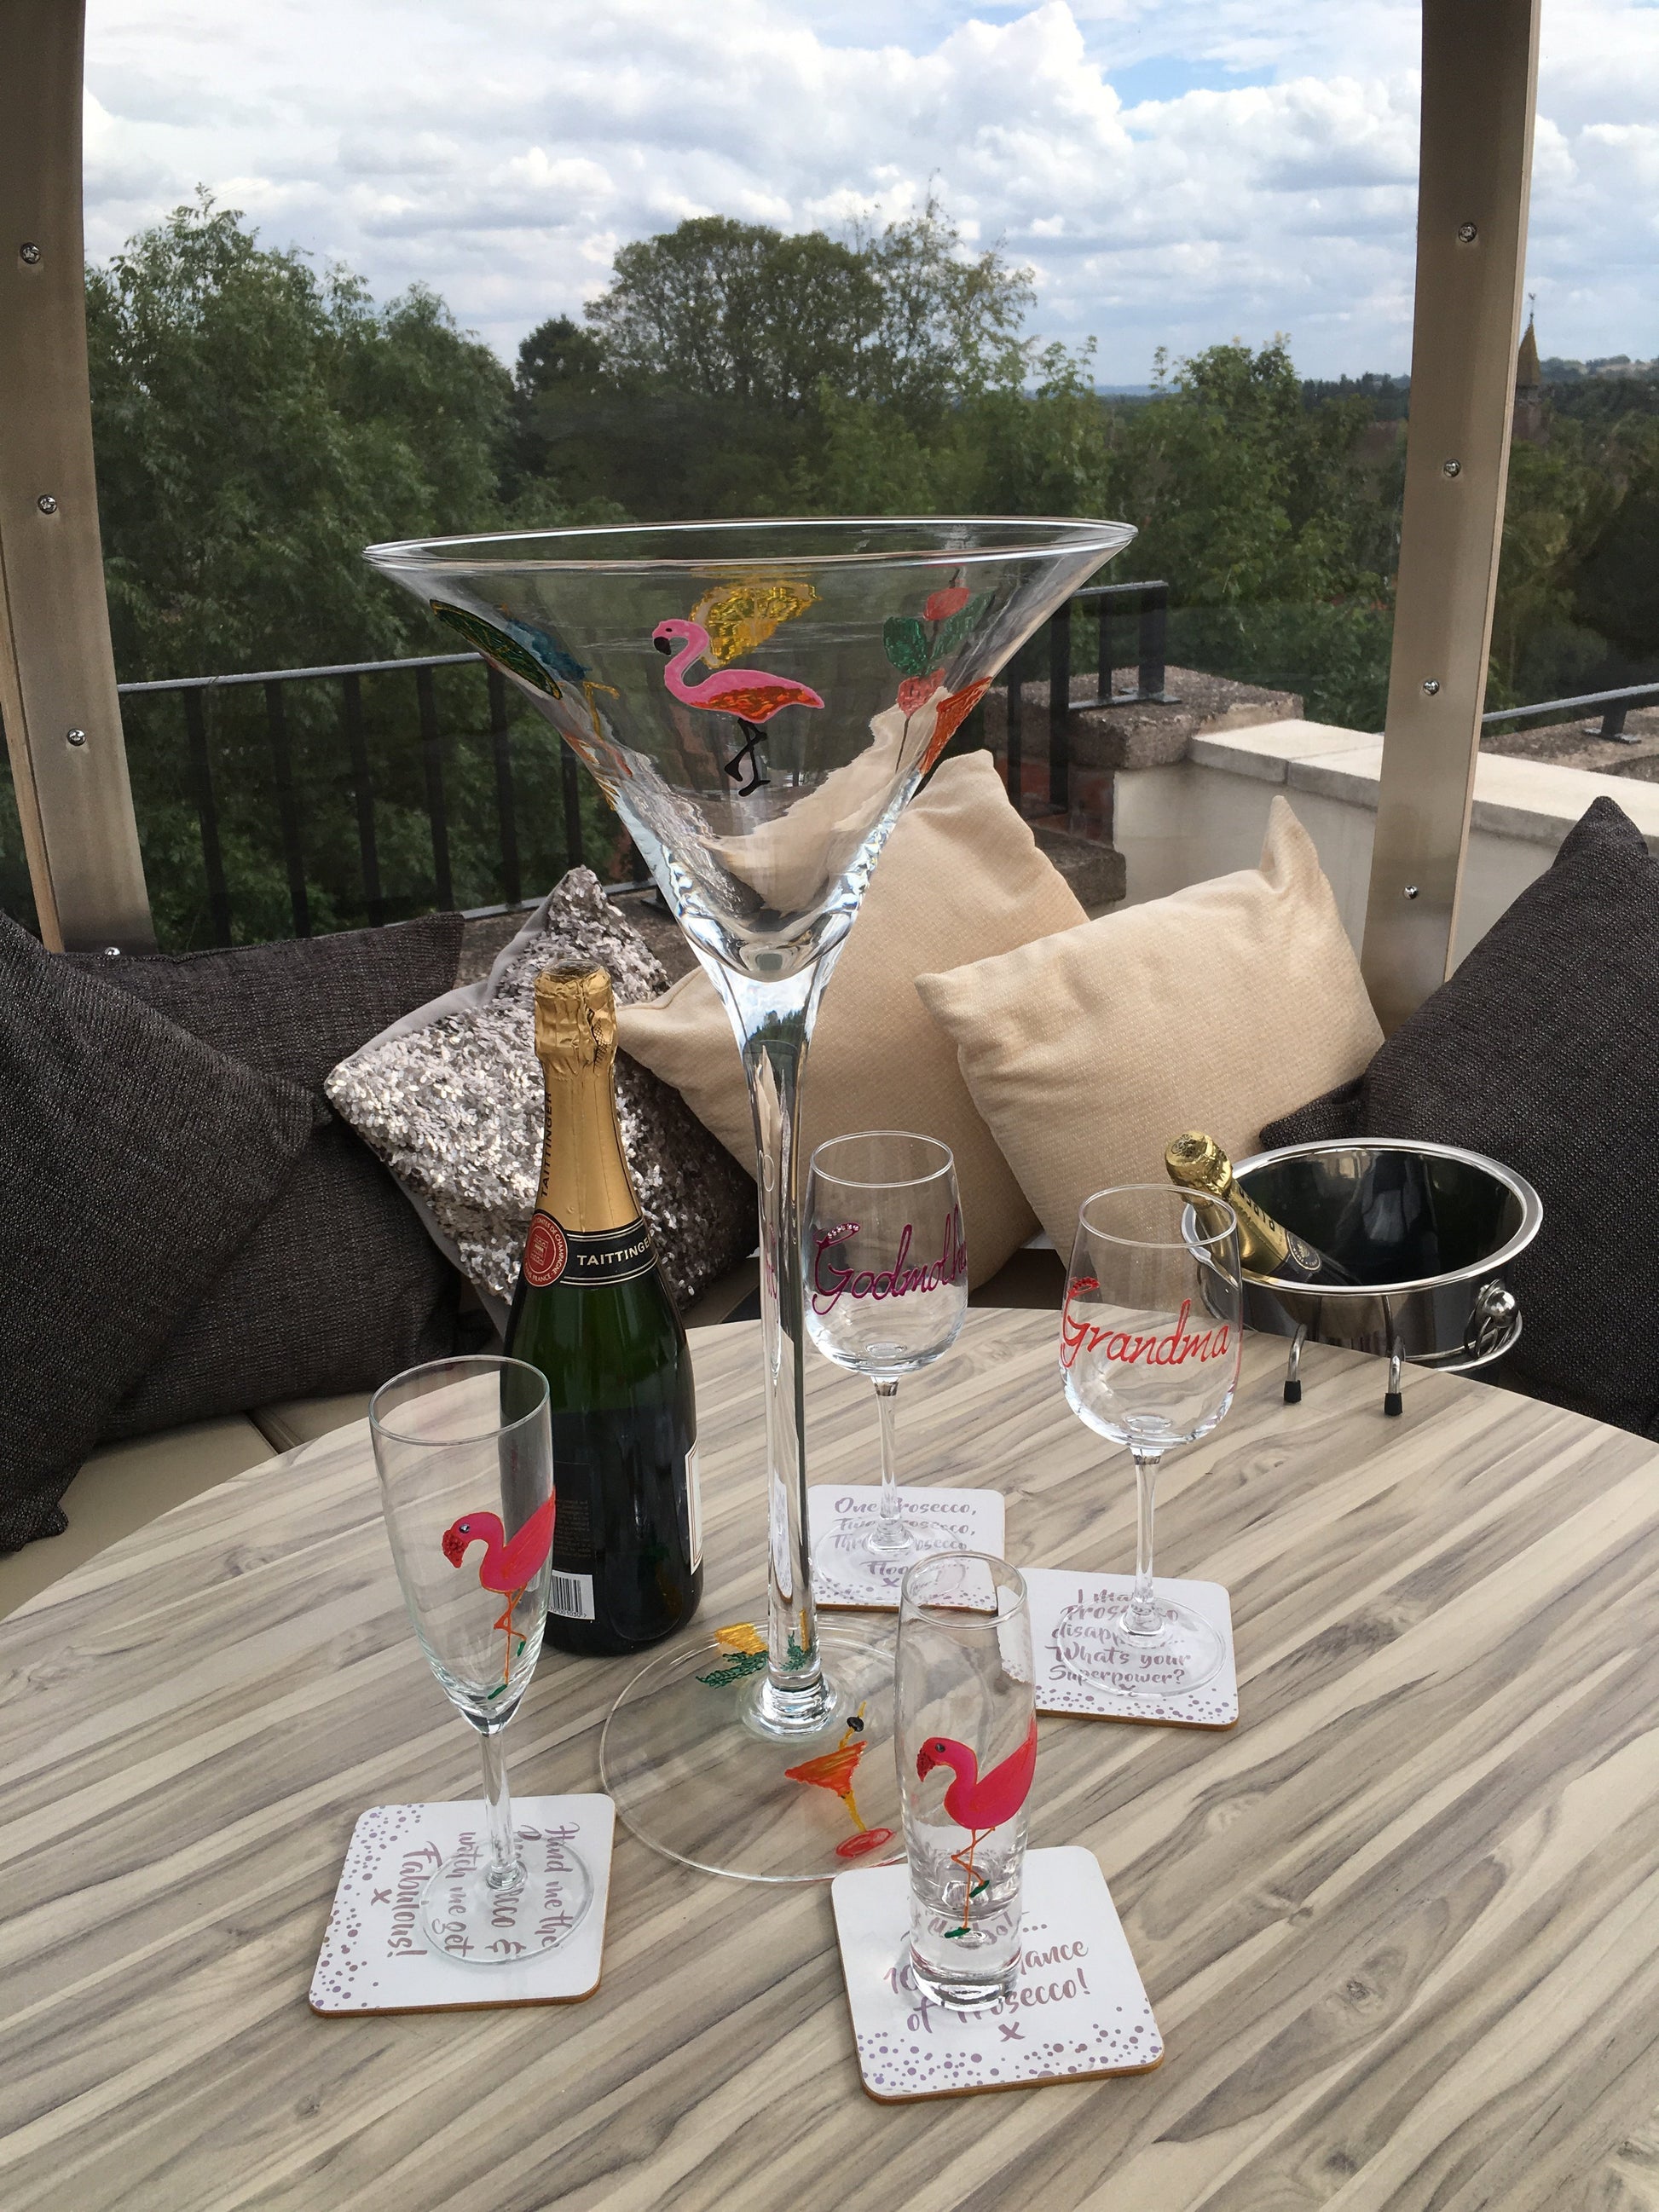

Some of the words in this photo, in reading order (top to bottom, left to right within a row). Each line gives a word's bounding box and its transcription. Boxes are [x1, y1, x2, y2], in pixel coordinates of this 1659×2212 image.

[541, 1092, 552, 1198] TAITTINGER
[554, 1233, 564, 1275] CHAMPAGNE
[577, 1234, 652, 1266] TAITTINGE
[1061, 1277, 1229, 1368] Grandma
[835, 1497, 877, 1514] One
[1044, 1641, 1130, 1666] What's
[1140, 1654, 1192, 1669] your
[1049, 1665, 1186, 1686] Superpower?
[387, 1841, 442, 1958] Fabulous!
[448, 1886, 467, 1915] me
[544, 1880, 565, 1910] me
[431, 1918, 475, 1957] get
[535, 1910, 574, 1949] the
